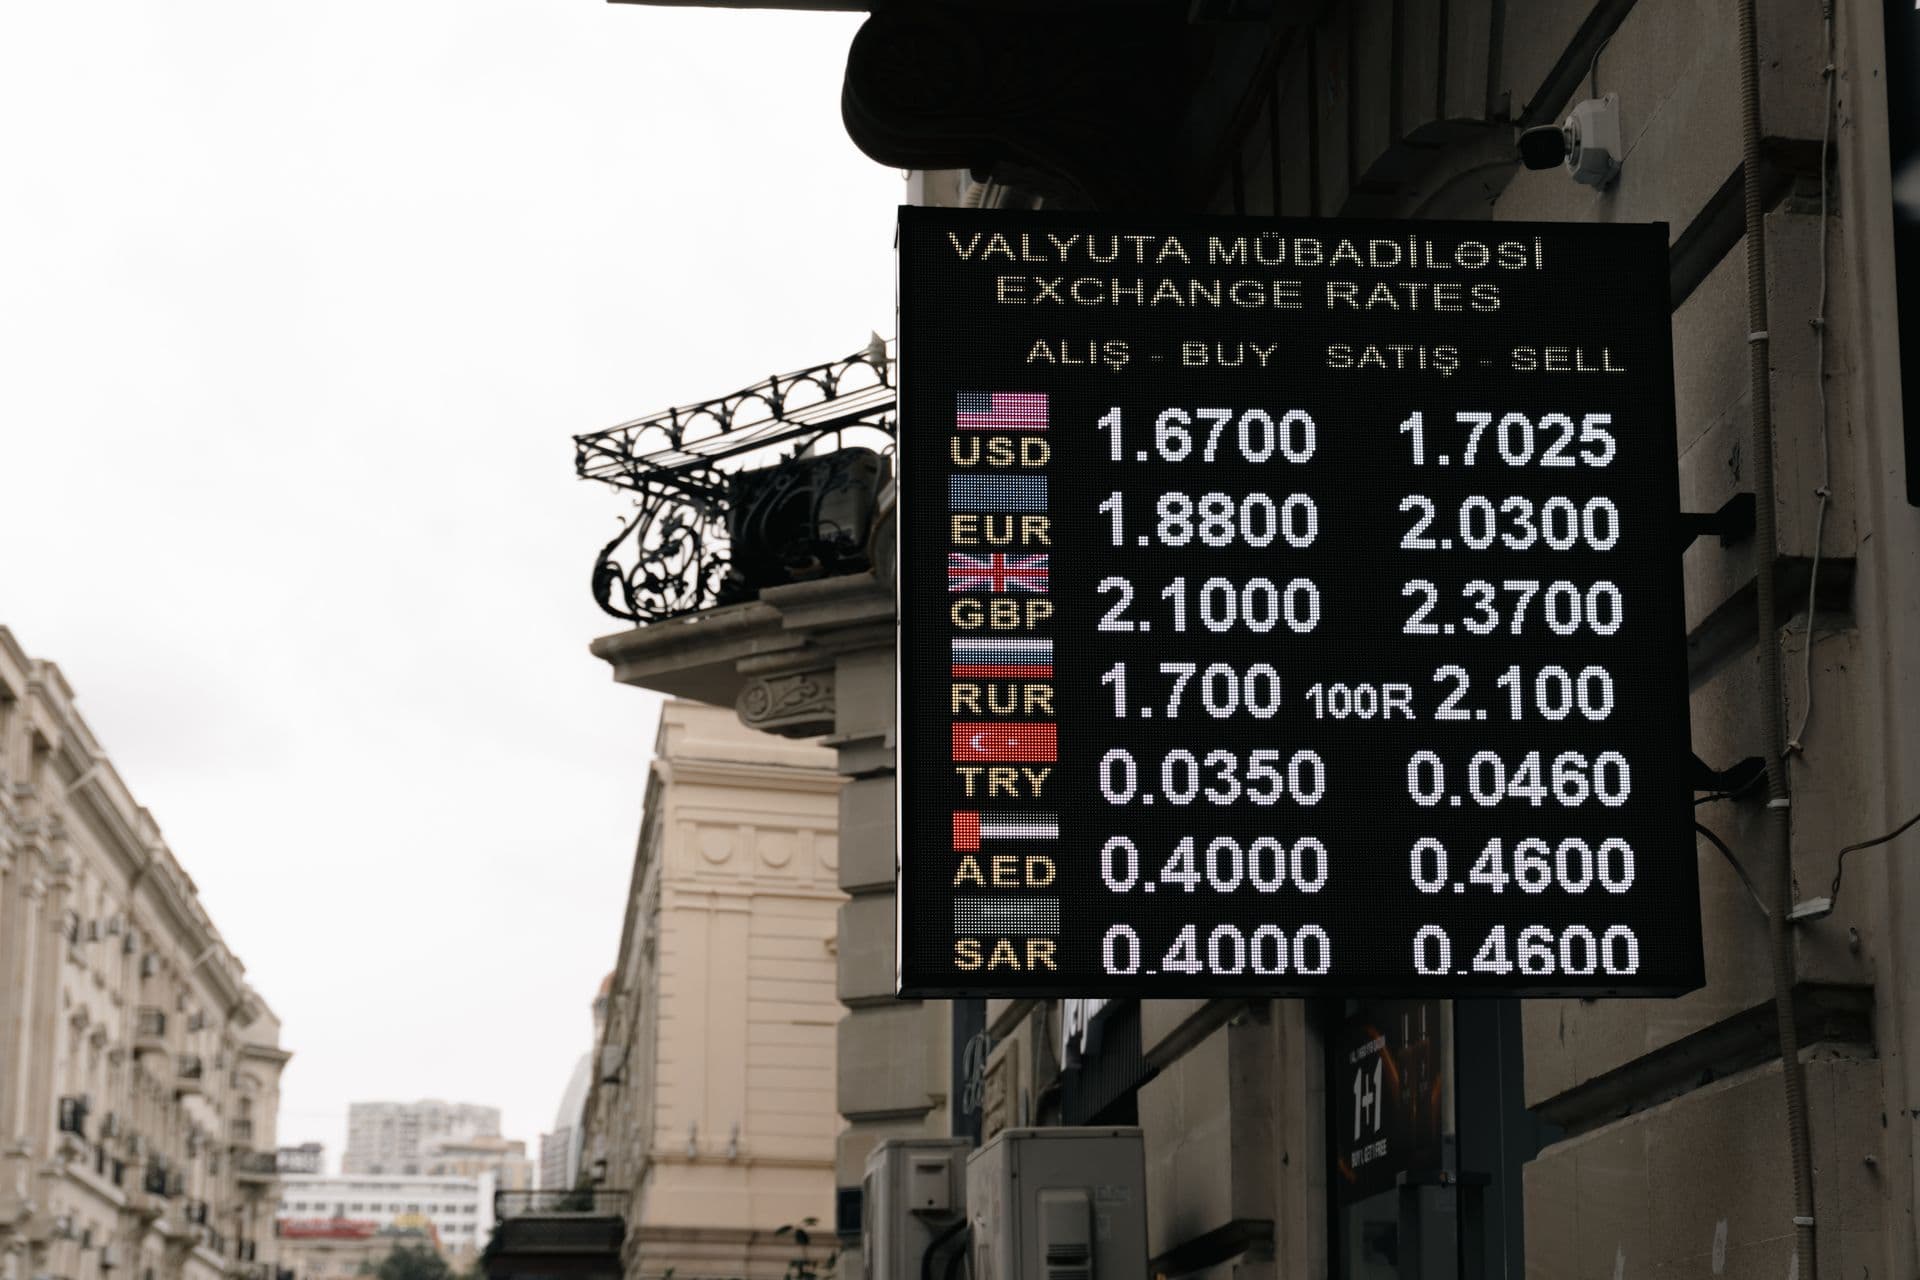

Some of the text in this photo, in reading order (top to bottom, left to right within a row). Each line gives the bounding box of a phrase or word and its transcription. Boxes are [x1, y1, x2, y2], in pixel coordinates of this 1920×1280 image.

[948, 232, 1192, 264] VALYUTA
[997, 276, 1500, 311] EXCHANGE RATES
[1026, 339, 1130, 372] ALIŞ
[1182, 341, 1278, 367] BUY
[1326, 344, 1459, 377] SATIŞ
[1512, 346, 1627, 372] SELL
[951, 407, 1616, 467] USD 1.6700 1.7025
[951, 492, 1619, 550] EUR 1.8800 2.0300
[951, 577, 1622, 635] GBP 2.1000 2.3700
[952, 663, 1614, 720] RUR 1.700 100R 2.100
[956, 749, 1630, 806] TRY 0.0350 0.0460
[953, 836, 1634, 893] AED 0.4000 0.4600
[954, 939, 1057, 971] SAR
[1354, 1056, 1382, 1141] 1+1
